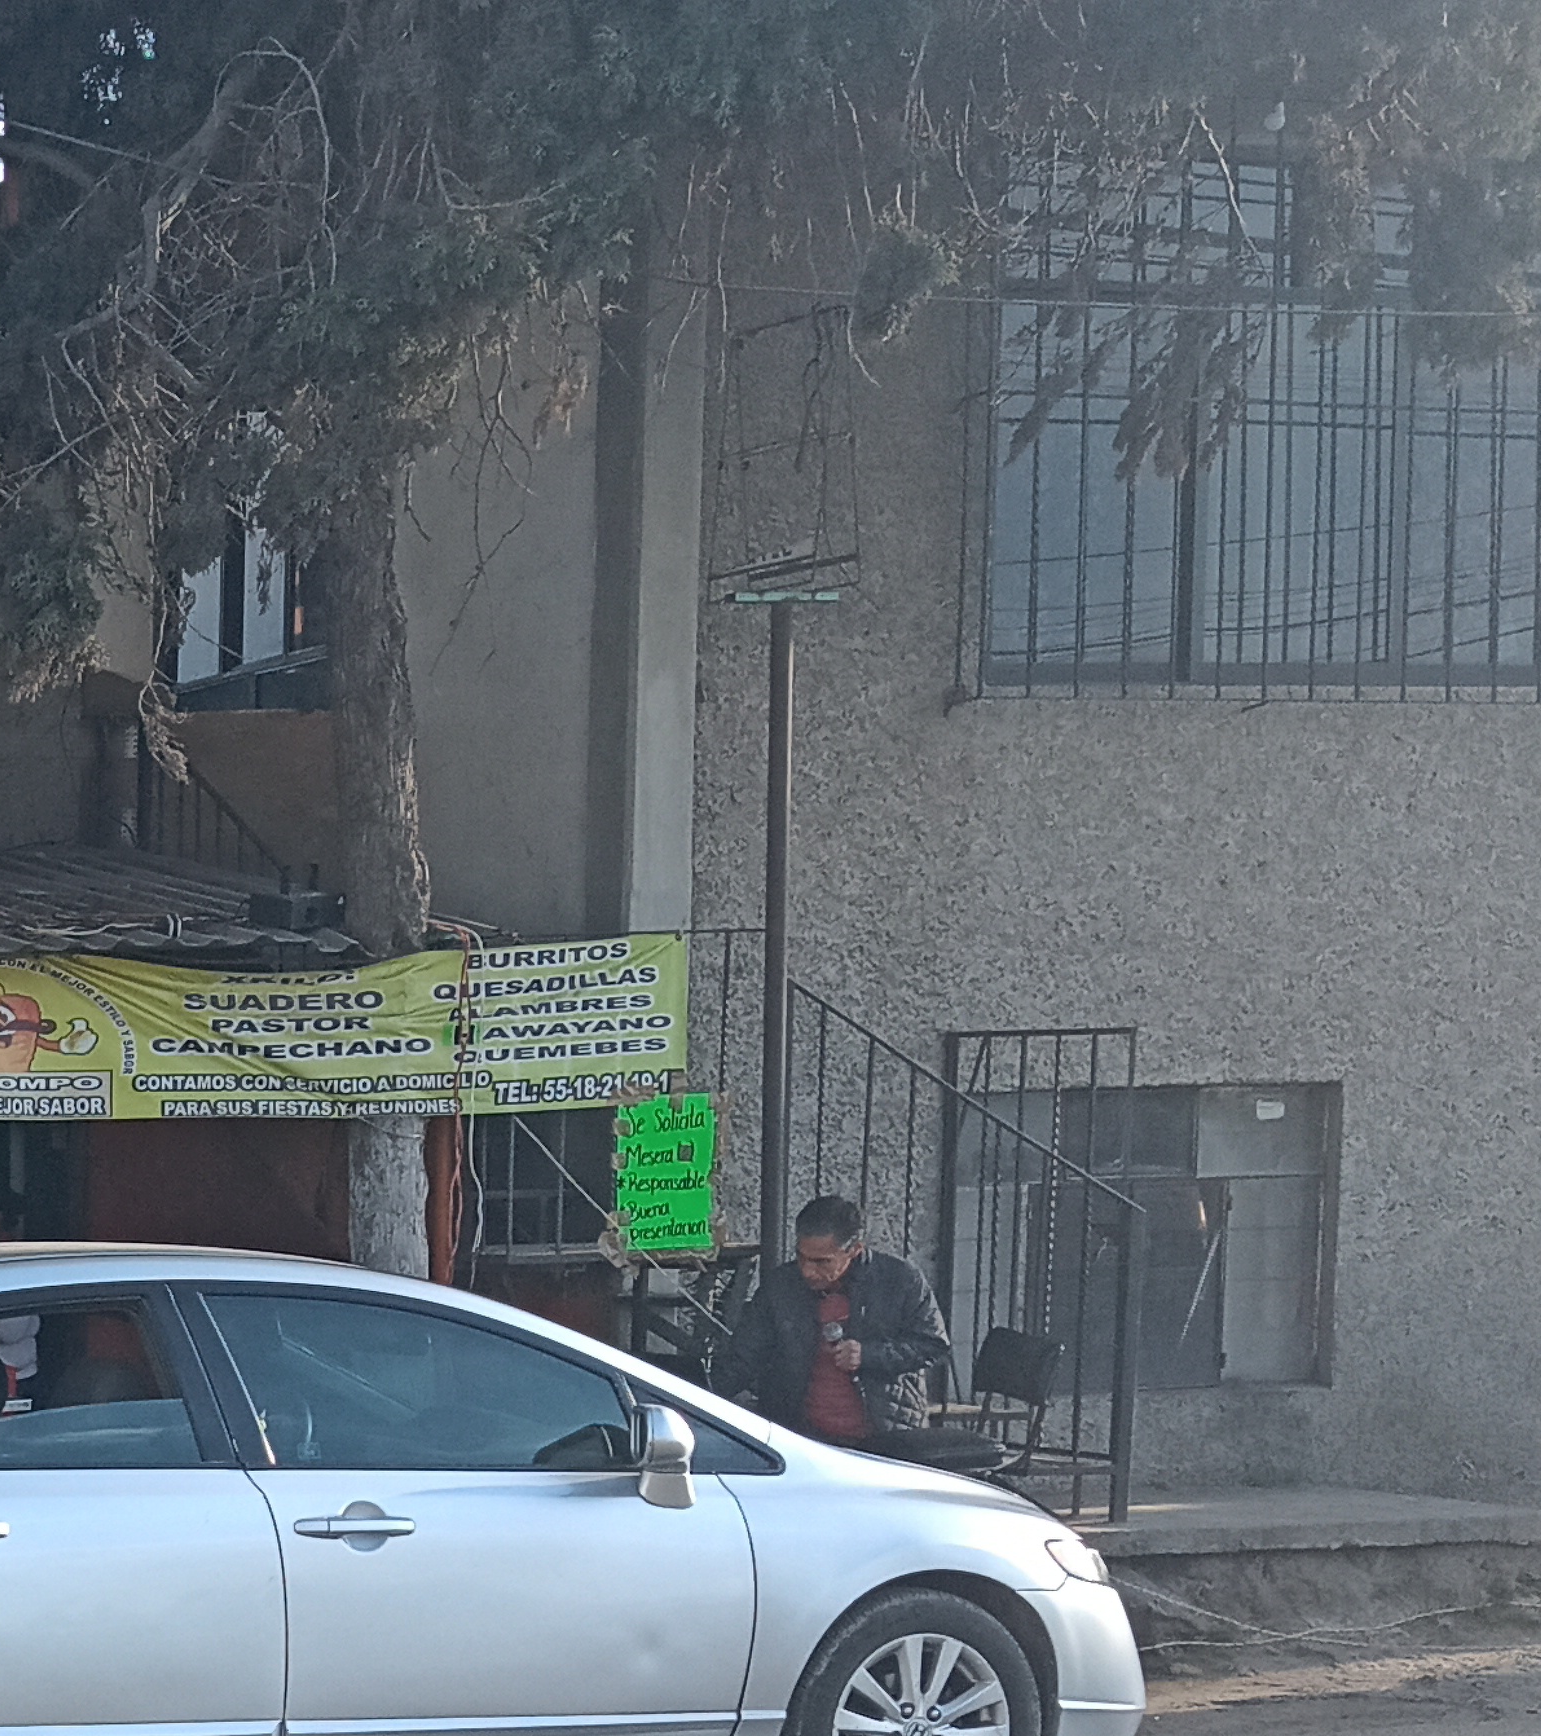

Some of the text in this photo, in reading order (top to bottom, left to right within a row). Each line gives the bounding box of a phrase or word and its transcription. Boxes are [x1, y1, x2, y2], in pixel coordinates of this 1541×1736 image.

[467, 942, 629, 971] BURRITOS
[48, 968, 93, 997] MEJOR
[92, 994, 126, 1028] ESTILO
[183, 990, 385, 1012] SUADERO
[448, 994, 653, 1022] ALAMBRES
[119, 1026, 131, 1037] Y
[211, 1016, 372, 1034] PASTOR
[122, 1039, 134, 1075] SABOR
[151, 1038, 433, 1059] CAMPECHANO
[453, 1039, 667, 1063] QUEMEBES
[133, 1070, 493, 1095] CONTAMOS CON SERVICIO A DOMICLO
[495, 1080, 538, 1104] TEL:
[38, 1098, 106, 1116] SABOR
[162, 1098, 463, 1117] PARA SUS FIESTAS Y REUNIONES
[626, 1103, 705, 1138] Se Solicita
[625, 1144, 674, 1169] Mesera
